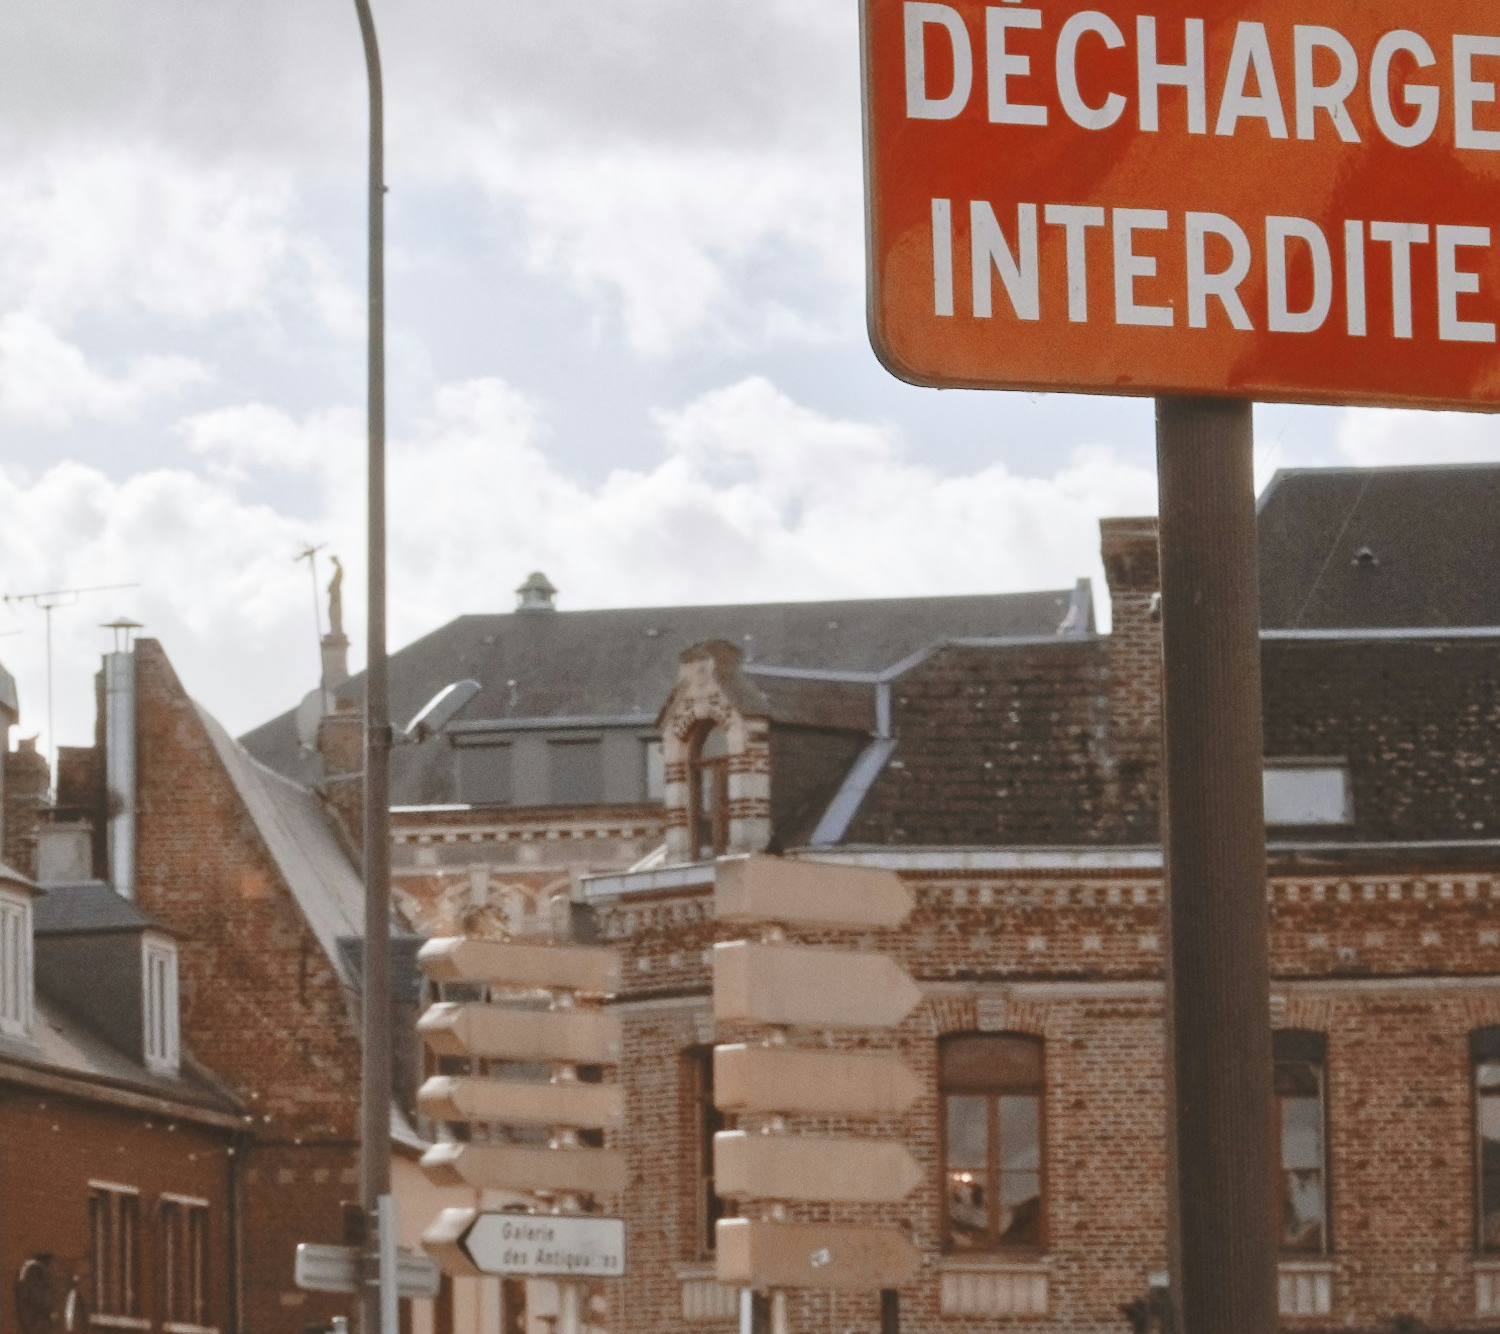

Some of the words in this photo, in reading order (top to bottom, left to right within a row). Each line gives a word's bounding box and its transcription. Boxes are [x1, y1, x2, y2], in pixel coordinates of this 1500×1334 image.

[931, 198, 1497, 343] INTERDITE
[502, 1222, 554, 1241] Galerie
[503, 1250, 528, 1266] des
